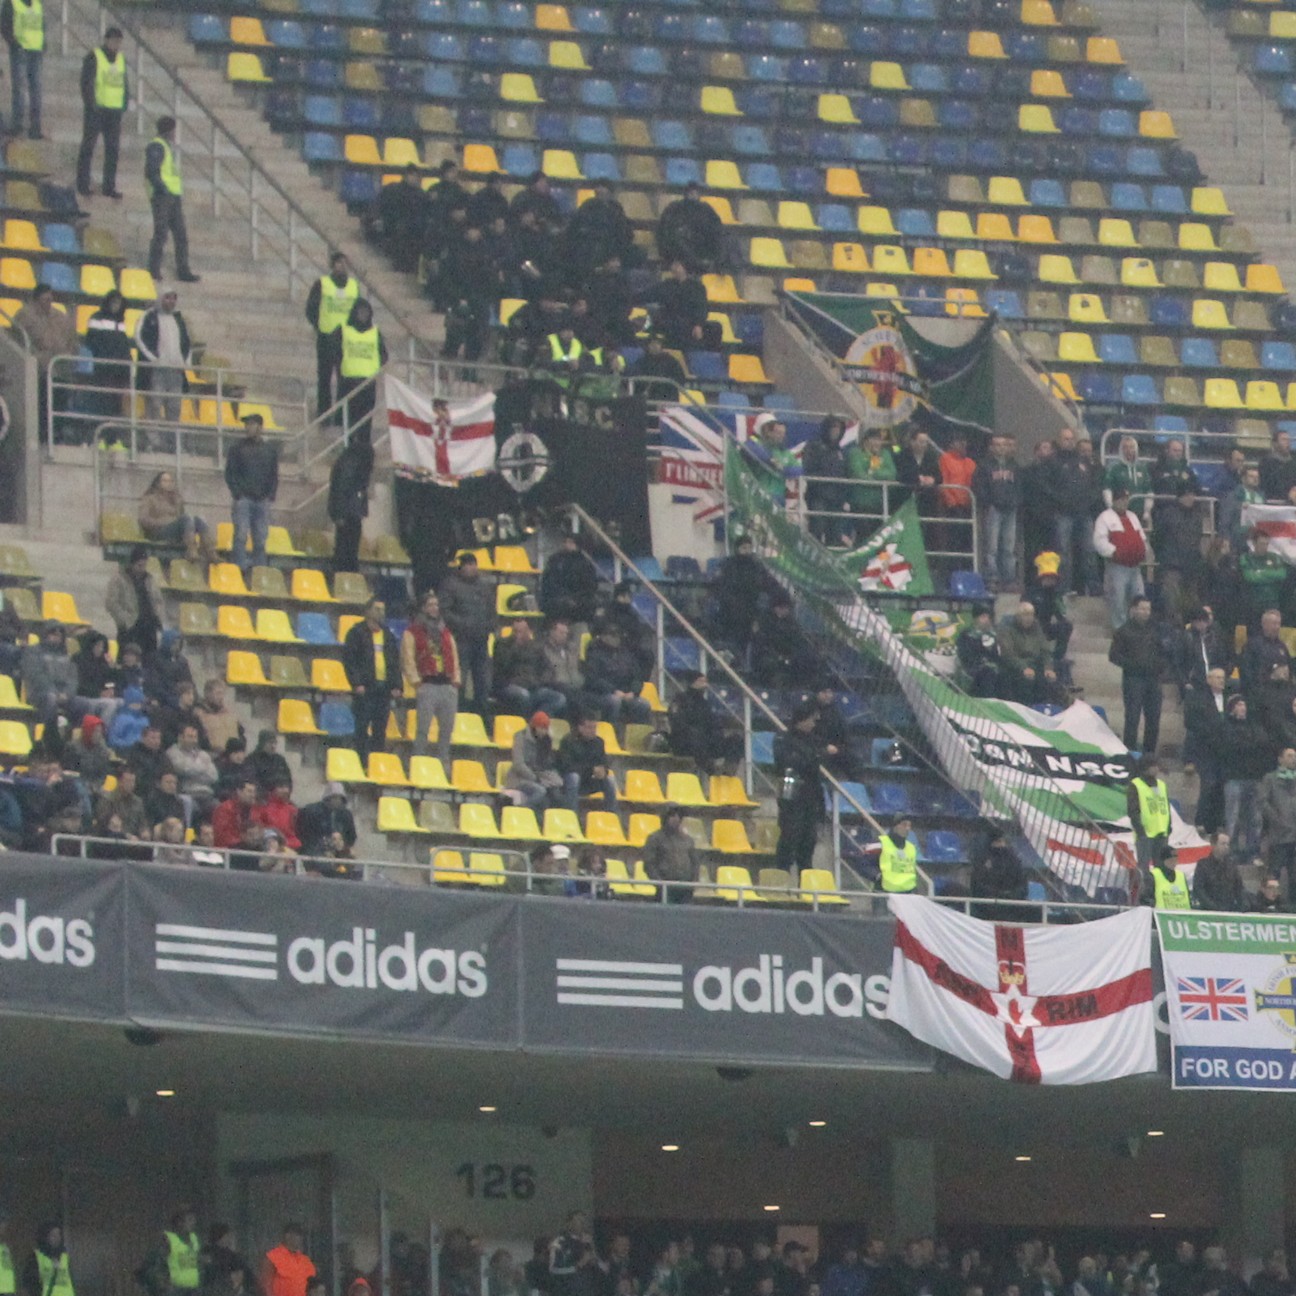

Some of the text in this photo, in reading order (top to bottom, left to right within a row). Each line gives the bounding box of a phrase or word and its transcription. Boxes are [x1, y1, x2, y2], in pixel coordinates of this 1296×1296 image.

[287, 927, 488, 998] adidas
[1181, 1058, 1230, 1079] FOR
[1235, 1060, 1283, 1081] GOD
[455, 1162, 537, 1200] 126
